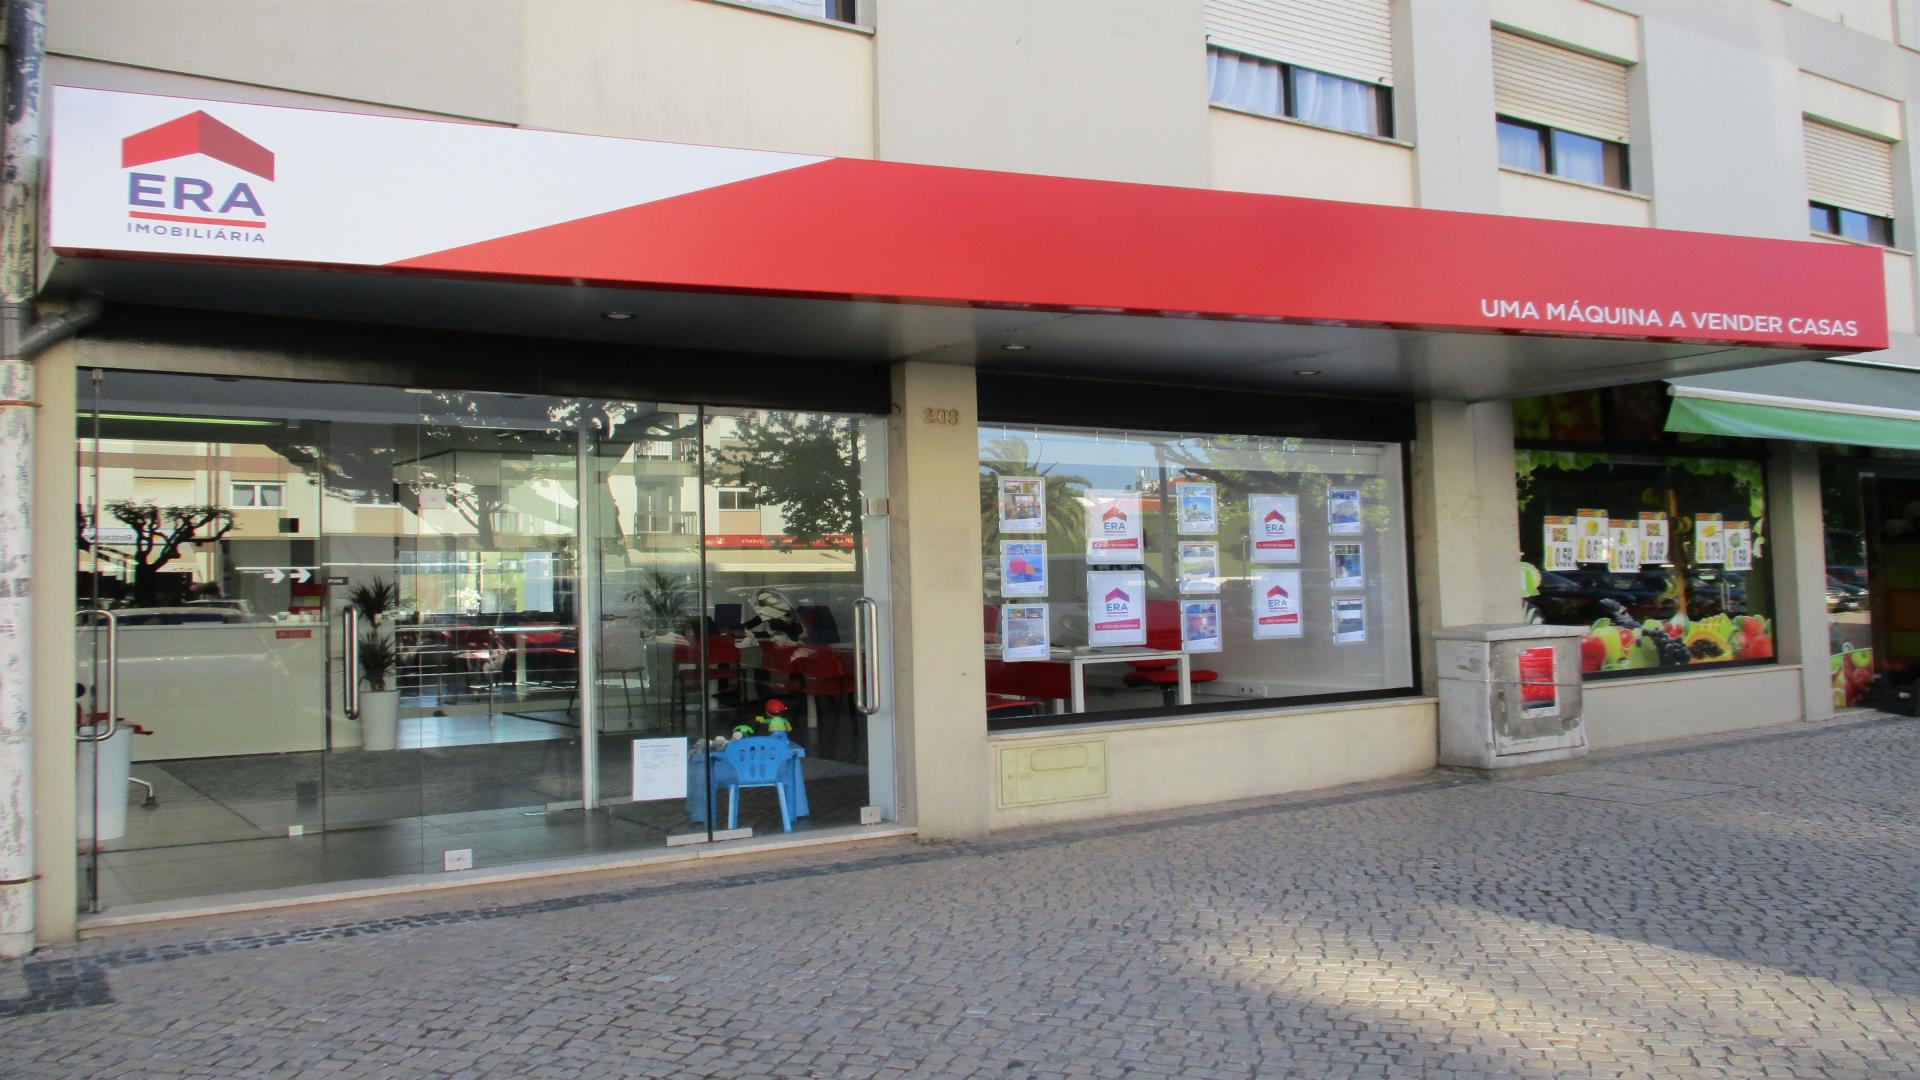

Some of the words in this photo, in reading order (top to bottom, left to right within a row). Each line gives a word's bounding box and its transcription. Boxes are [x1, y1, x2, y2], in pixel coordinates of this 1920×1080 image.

[128, 171, 266, 217] ERA
[127, 222, 266, 243] IMOBILIÁRIA
[1480, 298, 1540, 320] UMA
[1546, 299, 1664, 328] MÁQUINA
[1669, 311, 1687, 328] A
[1691, 311, 1784, 334] VENDER
[1788, 317, 1859, 337] CASAS
[1103, 522, 1126, 530] ERA
[1265, 523, 1285, 531] ERA
[1106, 603, 1128, 611] ERA
[1268, 599, 1288, 607] ERA
